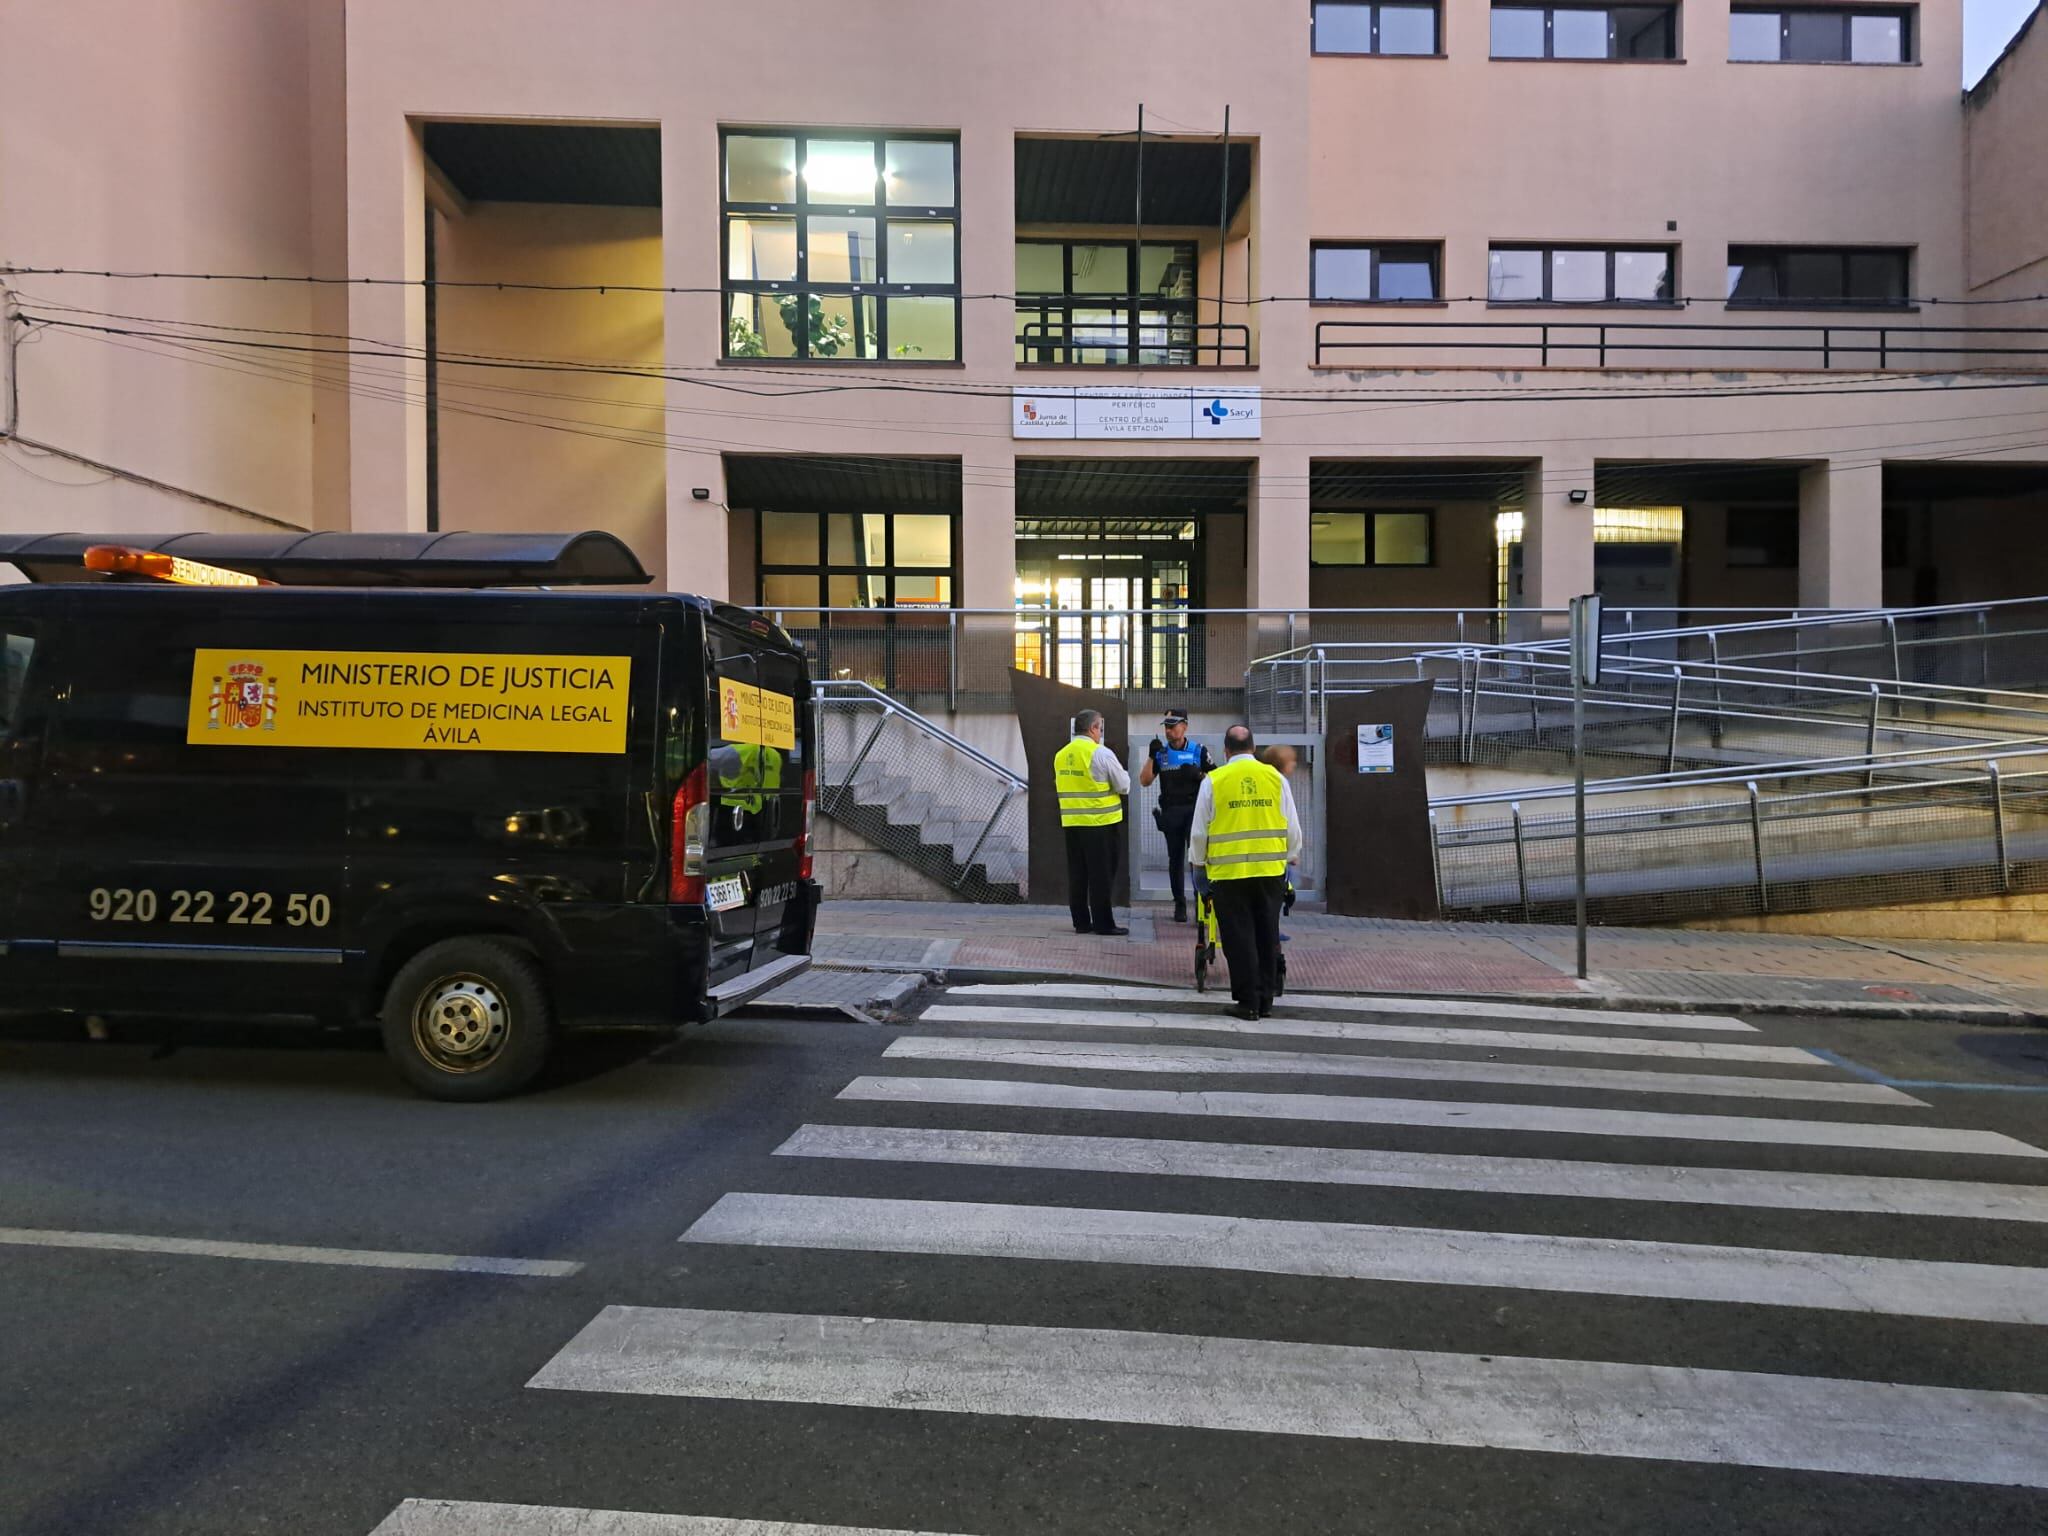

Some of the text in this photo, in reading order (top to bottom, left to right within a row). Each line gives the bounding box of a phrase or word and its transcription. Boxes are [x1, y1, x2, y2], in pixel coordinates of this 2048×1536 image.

[1230, 409, 1253, 419] Sacyl
[1104, 424, 1164, 432] ÁVILA ESTACIÓN
[301, 663, 614, 694] MINISTERIO DE JUSTICIA
[298, 700, 612, 722] INSTITUTO DE MEDICINA LEGAL
[423, 723, 481, 744] ÁVILA
[1228, 800, 1250, 809] SERVICIO
[90, 888, 331, 927] 920 22 22 50
